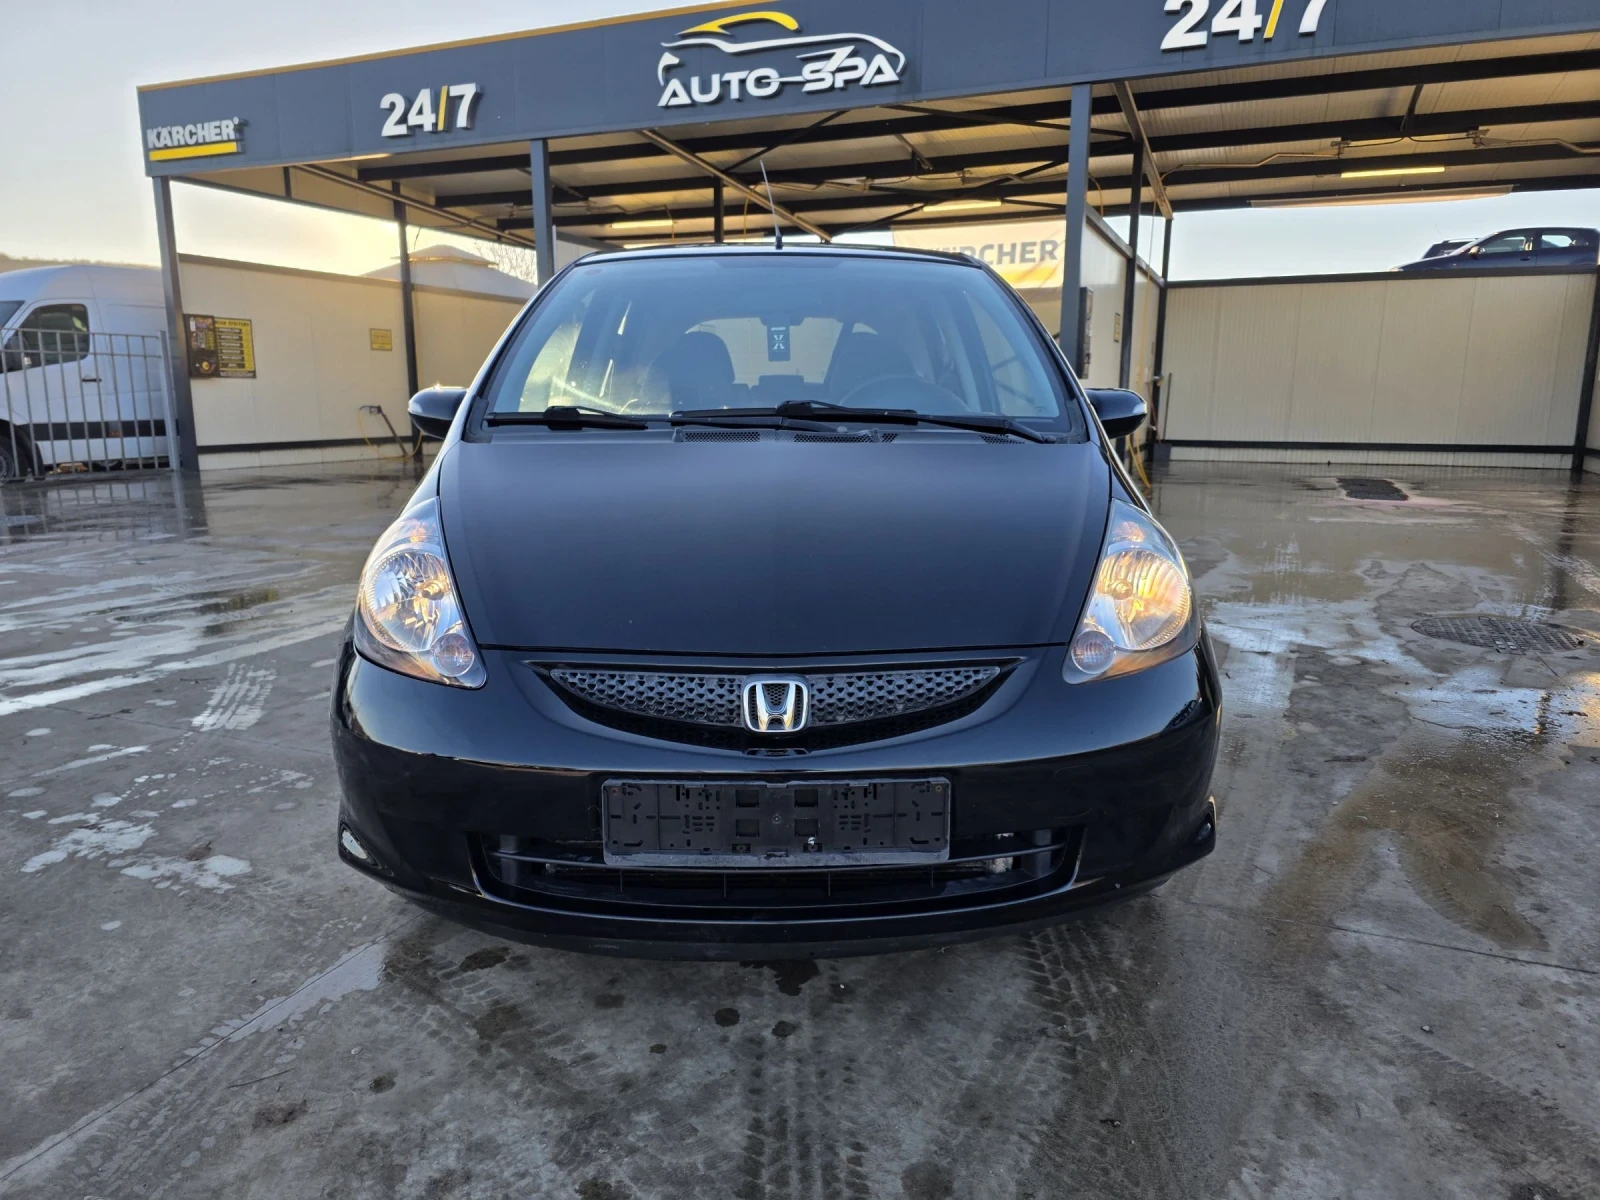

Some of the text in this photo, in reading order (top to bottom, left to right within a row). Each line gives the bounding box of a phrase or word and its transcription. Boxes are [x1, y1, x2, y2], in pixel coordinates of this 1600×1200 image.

[657, 47, 900, 107] AUTO SPA
[380, 82, 476, 137] 24/7
[147, 118, 236, 149] KÄRCHER
[932, 239, 1058, 265] RCHER
